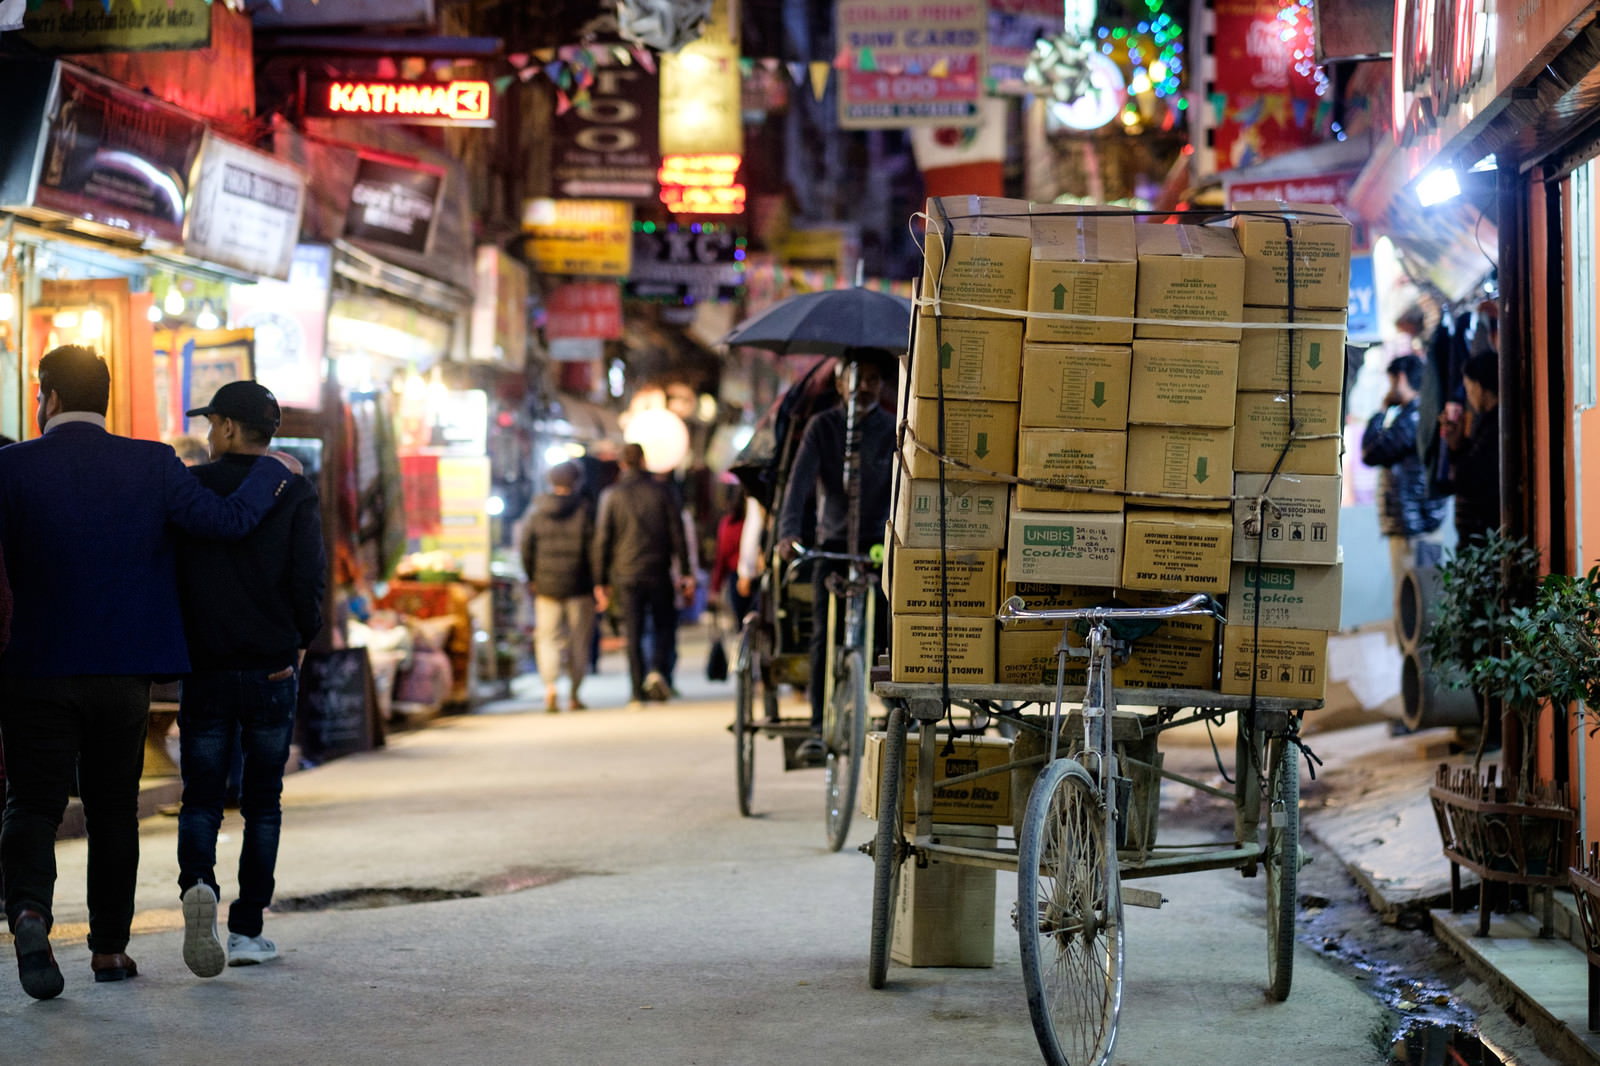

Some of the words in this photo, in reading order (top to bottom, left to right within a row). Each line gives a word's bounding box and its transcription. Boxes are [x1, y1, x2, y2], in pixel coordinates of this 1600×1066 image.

[904, 29, 979, 47] CARD
[1026, 530, 1071, 541] UNIBIS
[1022, 548, 1084, 558] Cookies
[1026, 597, 1072, 607] ookies
[1243, 592, 1303, 603] Cokies
